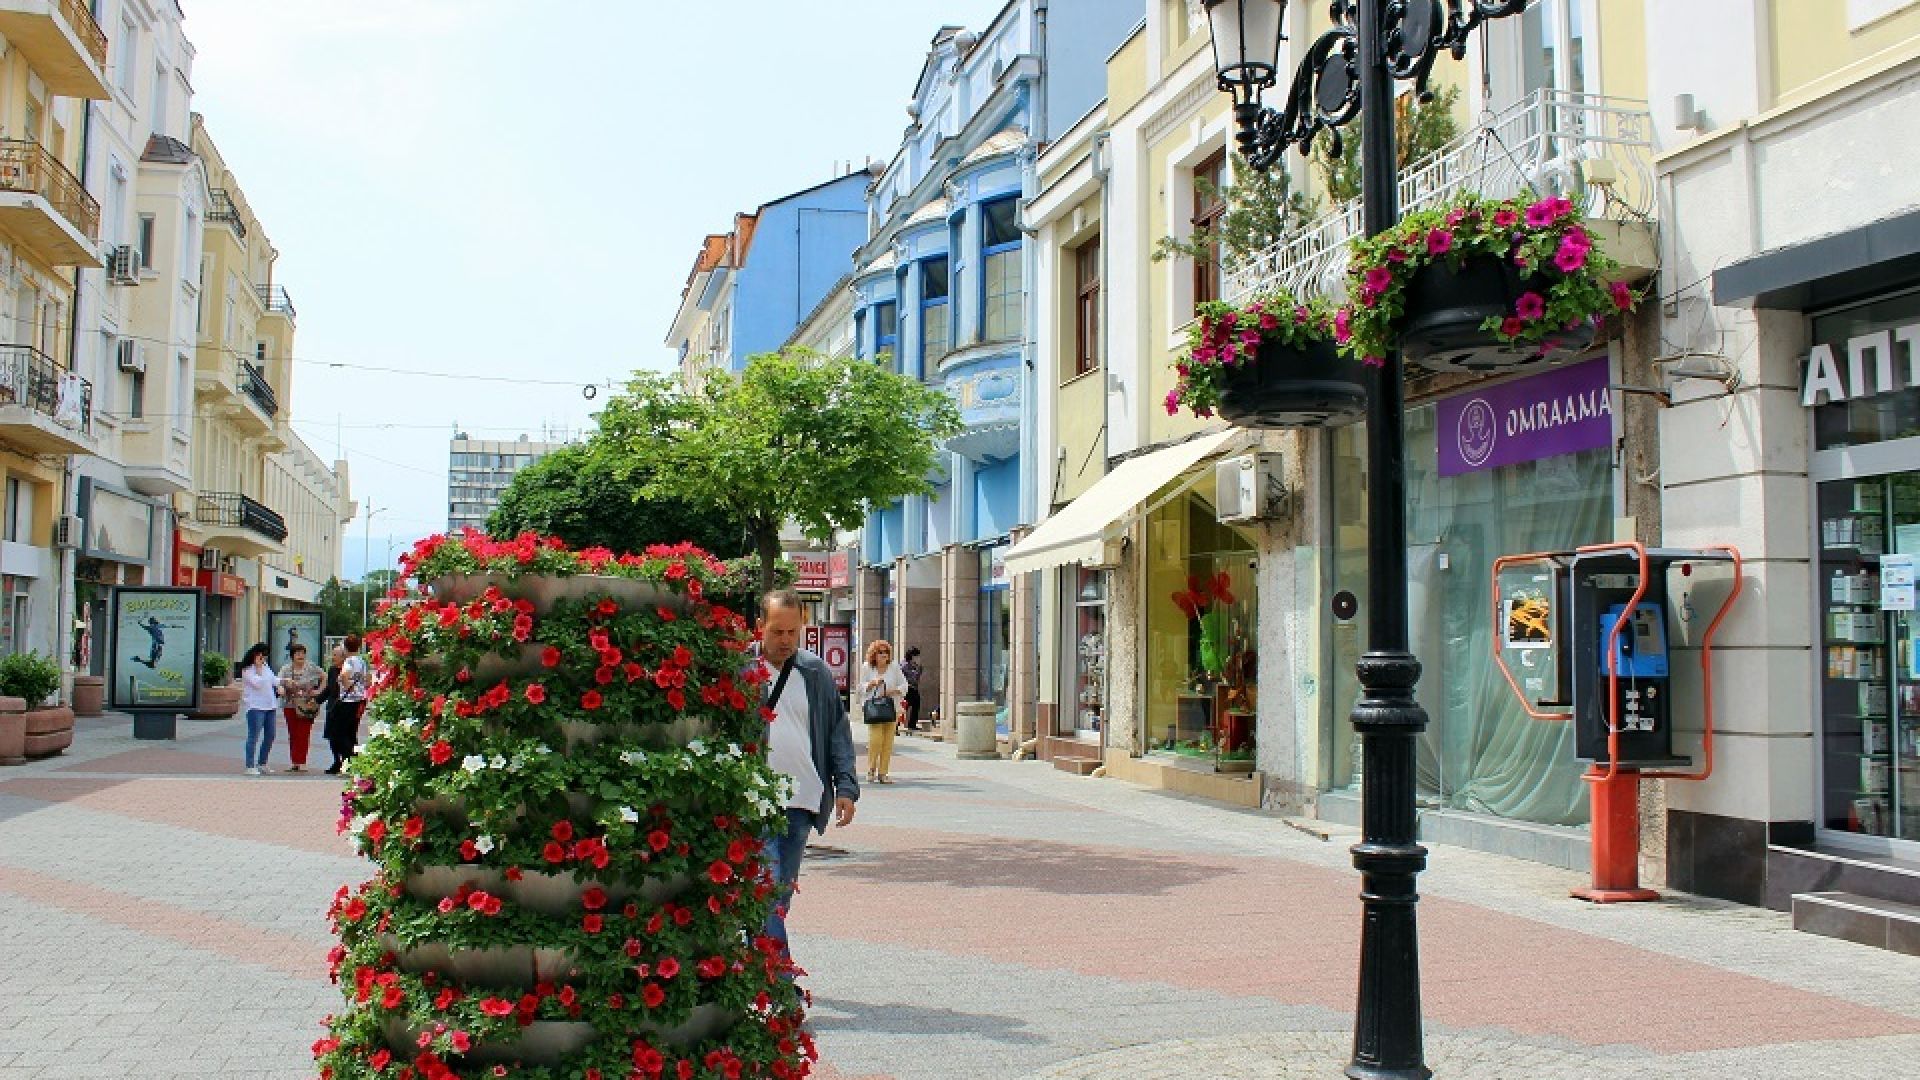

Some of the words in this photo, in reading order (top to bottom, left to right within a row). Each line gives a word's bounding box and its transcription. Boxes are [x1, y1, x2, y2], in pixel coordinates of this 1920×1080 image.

[1802, 324, 1920, 406] АПТ
[1506, 387, 1612, 437] OMRAAMA
[793, 561, 827, 575] HANGE
